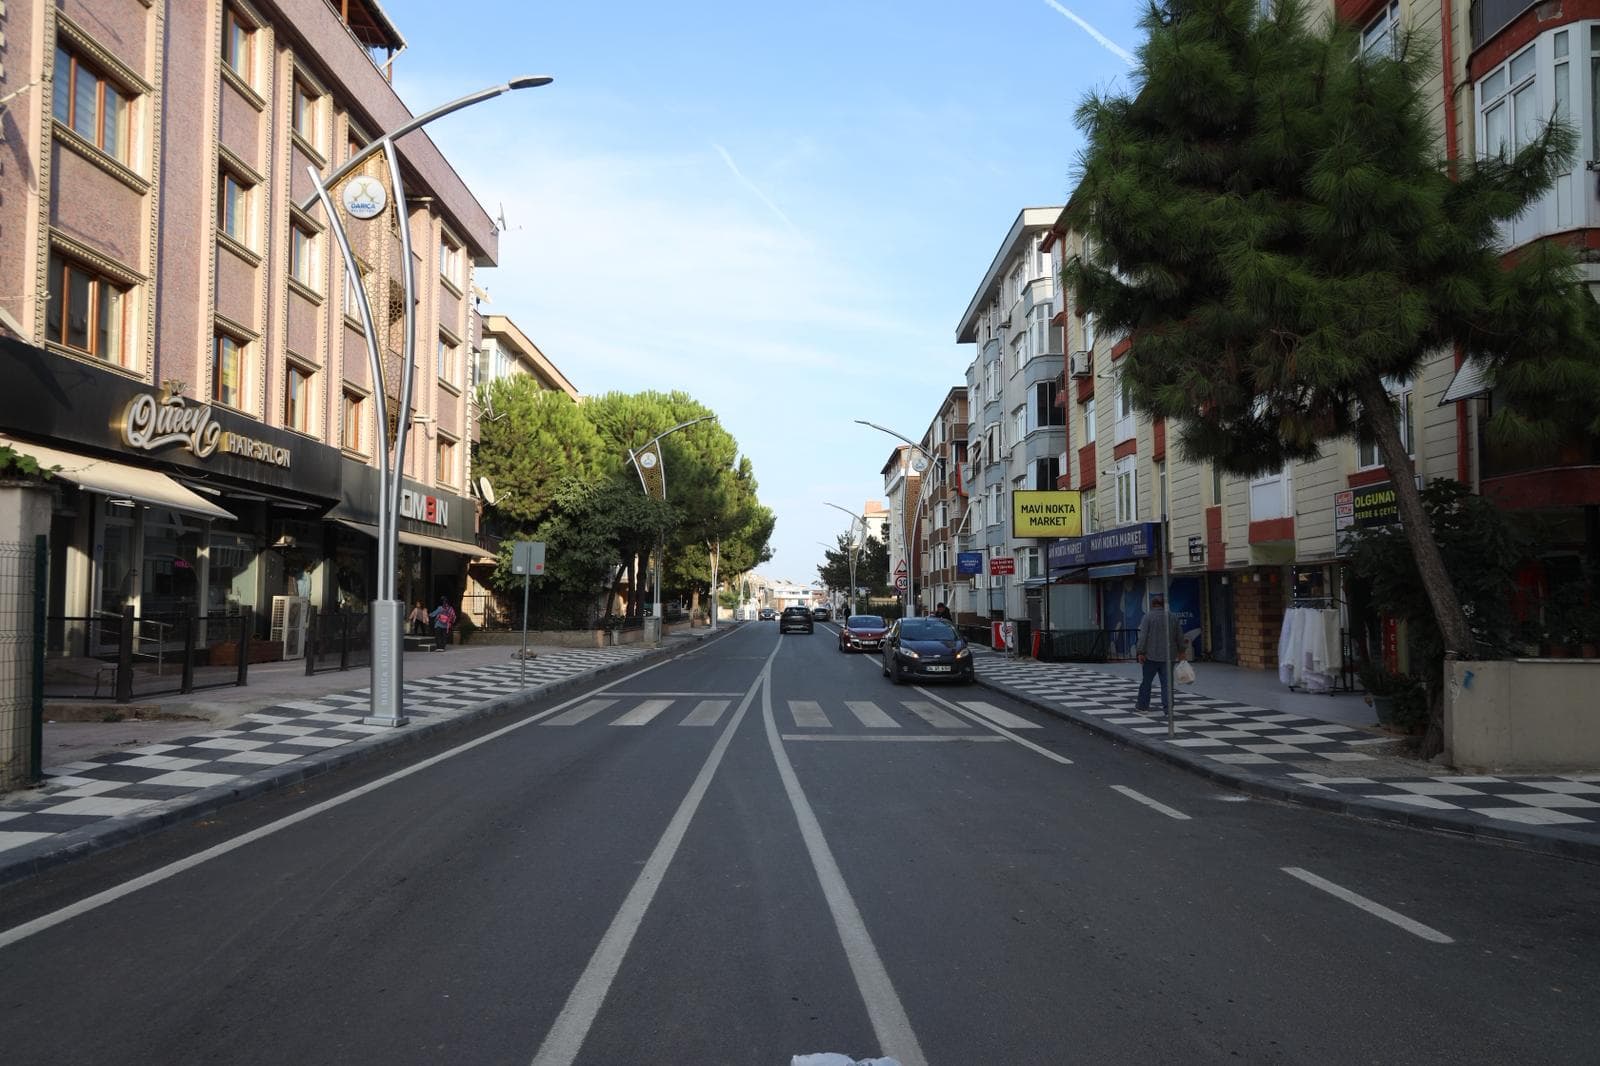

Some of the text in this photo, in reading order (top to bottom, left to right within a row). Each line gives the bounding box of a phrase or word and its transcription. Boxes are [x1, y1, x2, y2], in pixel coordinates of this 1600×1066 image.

[122, 393, 221, 458] Queen
[228, 432, 291, 467] HAIR SALON
[1354, 490, 1396, 508] OLGUNAY
[1021, 502, 1075, 514] MAVİ NOKTA
[1030, 517, 1067, 526] MARKET
[1120, 530, 1142, 546] MARKET
